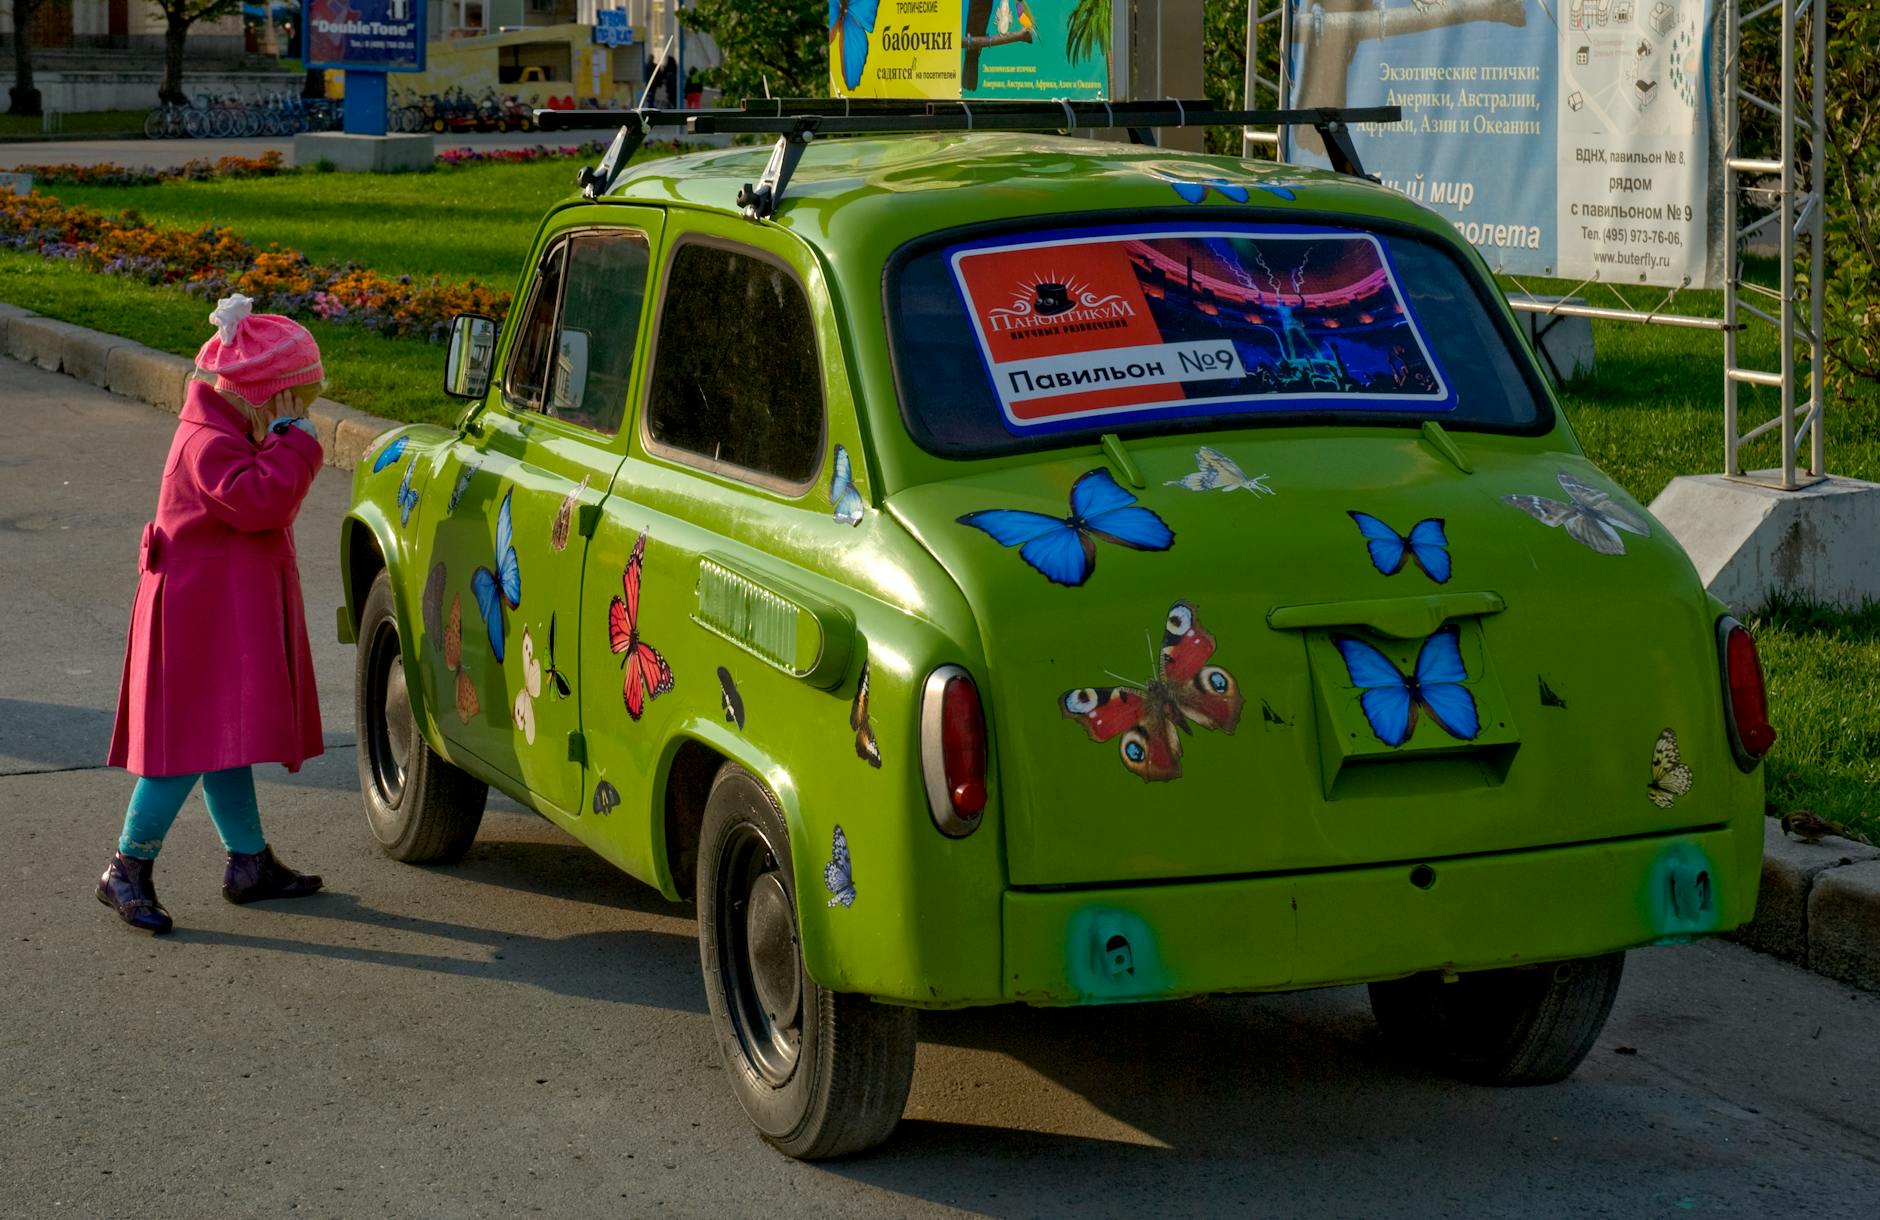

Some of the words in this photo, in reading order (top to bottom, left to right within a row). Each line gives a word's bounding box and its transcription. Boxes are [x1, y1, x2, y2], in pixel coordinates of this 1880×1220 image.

[896, 1, 938, 14] ТРОПИЧЕСКИЕ
[882, 25, 952, 51] бабочки
[876, 68, 912, 80] садятся
[923, 70, 956, 80] посетителей
[1380, 63, 1477, 81] Экзотические
[1481, 65, 1540, 81] птички:
[1386, 88, 1454, 112] Америки,
[1457, 88, 1541, 112] Австралии,
[1421, 117, 1457, 134] Азии
[1460, 121, 1469, 133] и
[1473, 114, 1541, 135] Океании
[1576, 148, 1607, 164] ВДНХ,
[1610, 152, 1662, 164] павильон
[1665, 150, 1676, 164] №
[1609, 177, 1652, 193] рядом
[1430, 181, 1474, 211] мир
[1571, 203, 1578, 216] с
[1582, 204, 1662, 220] павильоном
[1667, 204, 1682, 220] №
[1684, 205, 1693, 222] 9
[1581, 226, 1601, 241] Тел.
[1603, 228, 1628, 245] (495)
[1630, 229, 1683, 247] 973-76-06,
[1594, 251, 1670, 269] www.buterfly.ru
[1008, 361, 1165, 393] Павильон
[1177, 349, 1234, 374] №9
